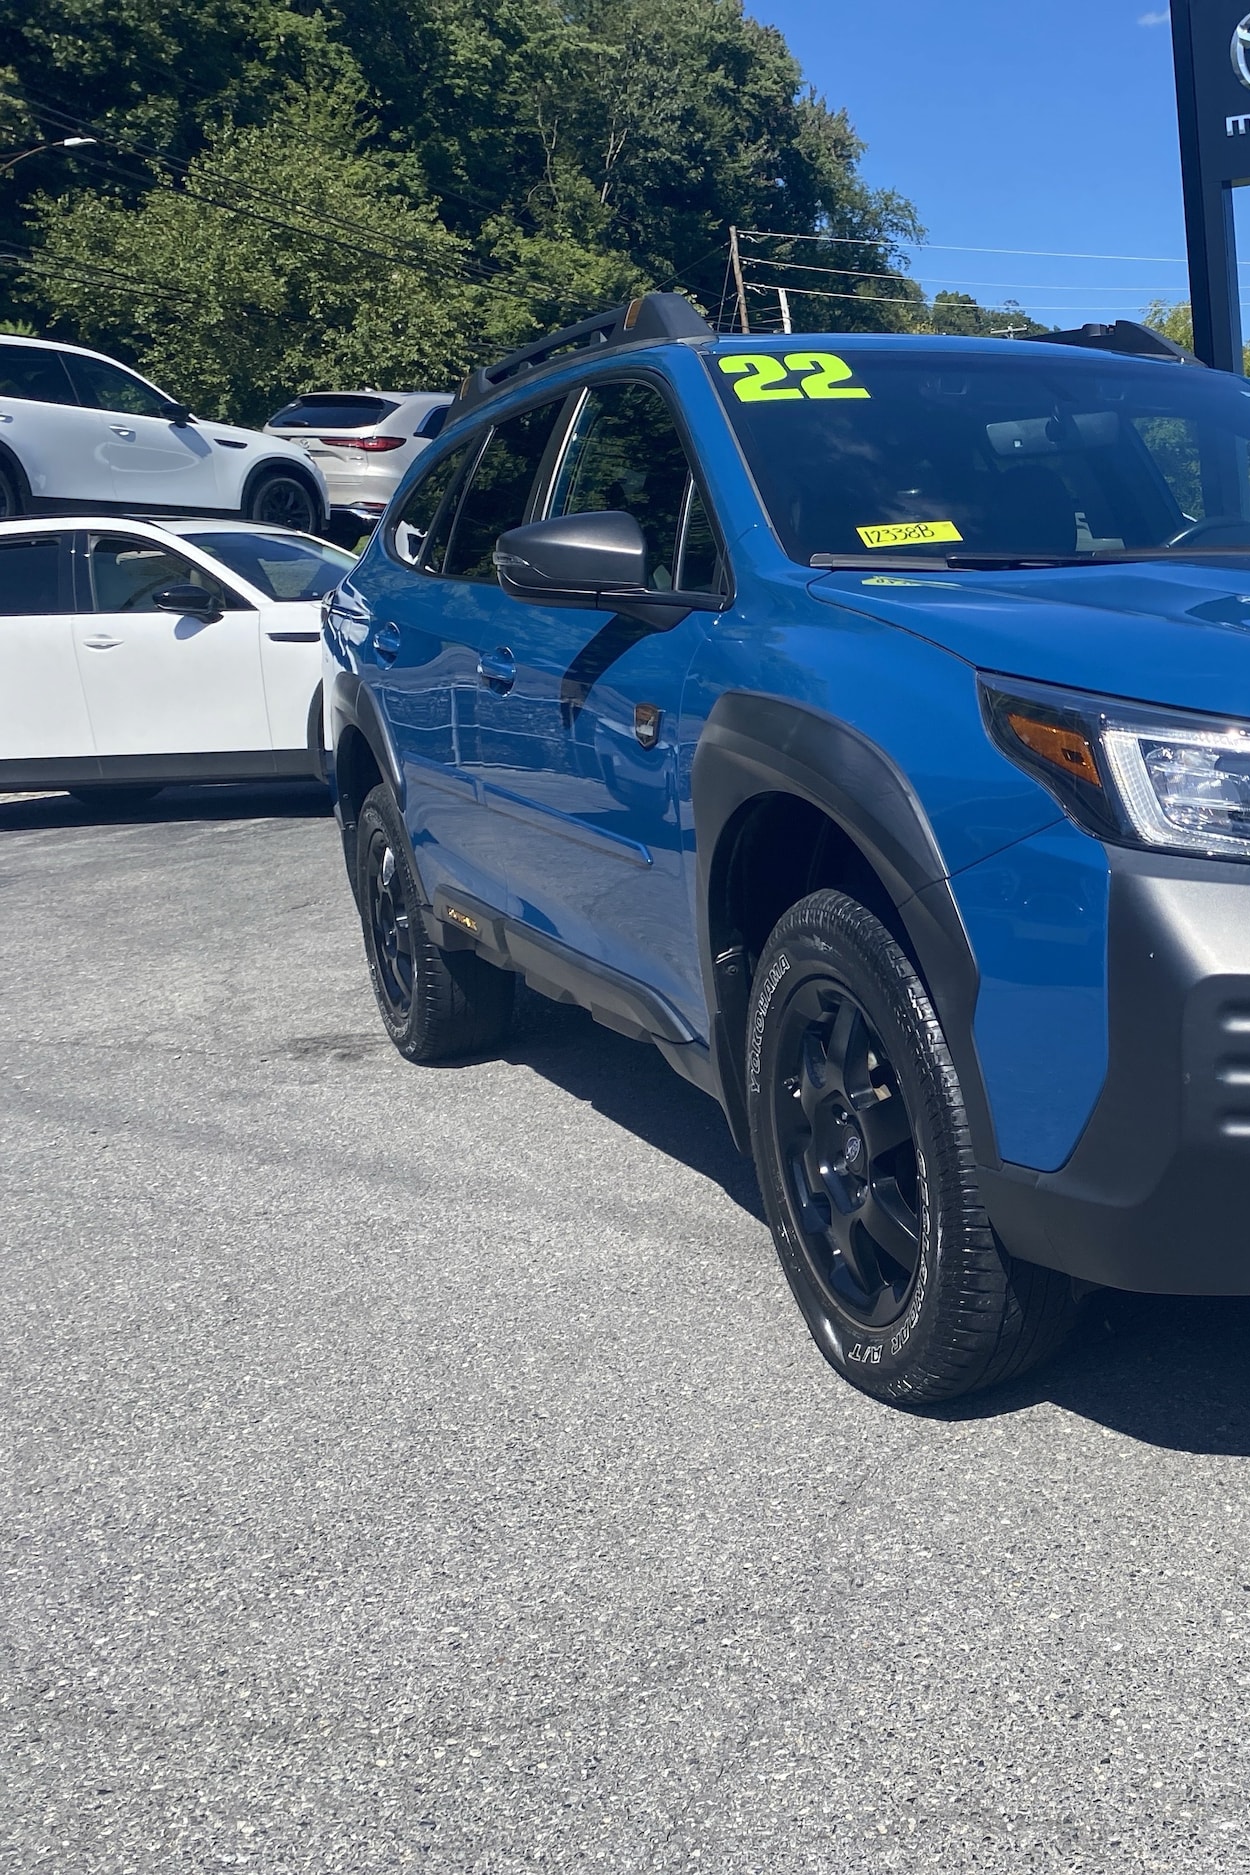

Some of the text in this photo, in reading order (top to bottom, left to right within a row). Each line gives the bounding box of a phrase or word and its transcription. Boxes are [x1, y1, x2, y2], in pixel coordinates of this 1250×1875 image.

[718, 352, 872, 402] 22
[864, 523, 936, 545] 12338B
[751, 953, 791, 1093] YOKOHAMA
[848, 1343, 884, 1364] A/T
